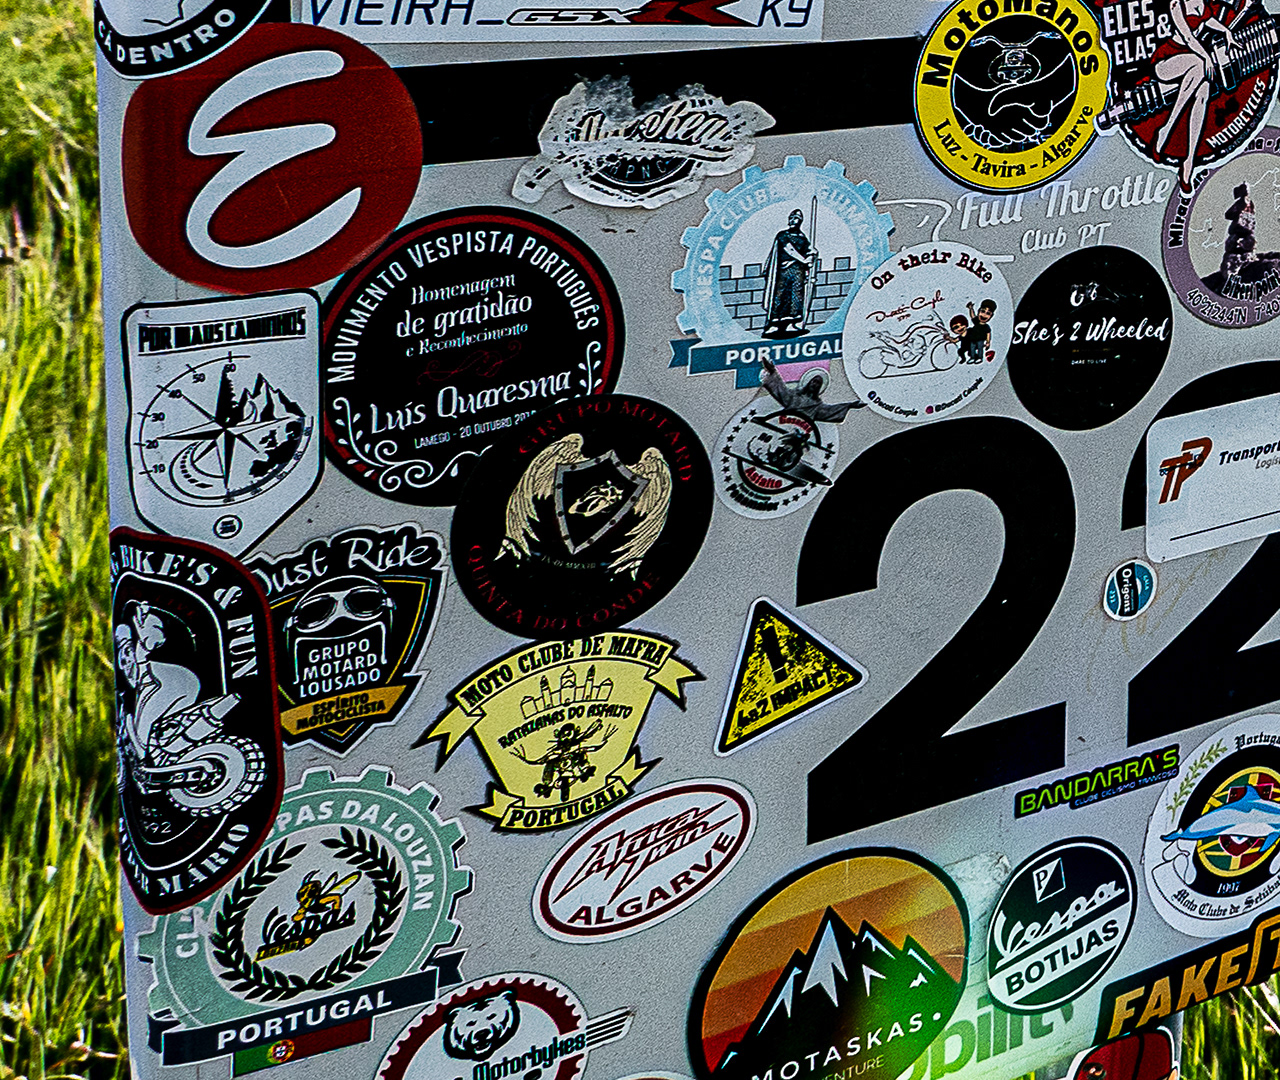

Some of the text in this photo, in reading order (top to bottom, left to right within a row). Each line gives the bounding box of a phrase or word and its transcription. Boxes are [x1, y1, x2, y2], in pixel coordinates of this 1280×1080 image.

[1113, 33, 1156, 66] ELAS
[1205, 77, 1268, 150] MOTORCYCLES
[932, 104, 1095, 179] Luz Tavira Algarve
[956, 171, 1172, 231] Full Throttle
[1019, 223, 1111, 254] Club PT
[410, 272, 516, 305] Homenagem
[871, 249, 995, 291] On their Bike
[326, 228, 601, 384] MOVIMENTO VESPISTA PORTUGUÊS
[395, 293, 534, 339] de gratidão
[725, 338, 843, 366] PORTUGAL
[1011, 316, 1170, 347] She's 2 Wheeled
[369, 367, 573, 439] Luís Quaresma
[119, 544, 259, 680] BIKE'S & FUN
[302, 652, 379, 682] MOTARD
[308, 635, 370, 664] GRUPO
[461, 633, 671, 709] MOTO CLUBE DE MAFRA
[299, 670, 382, 699] LOUSADO
[295, 699, 388, 731] MOTOCICLISTA
[1019, 748, 1179, 815] BANDARRA'S
[505, 783, 627, 830] PORTUGAL
[566, 831, 736, 926] ALGARVE
[1005, 921, 1121, 998] BOTIJAS
[1106, 943, 1247, 1040] FAKE
[216, 991, 393, 1051] PORTUGAL
[472, 1033, 587, 1080] Motorbykes
